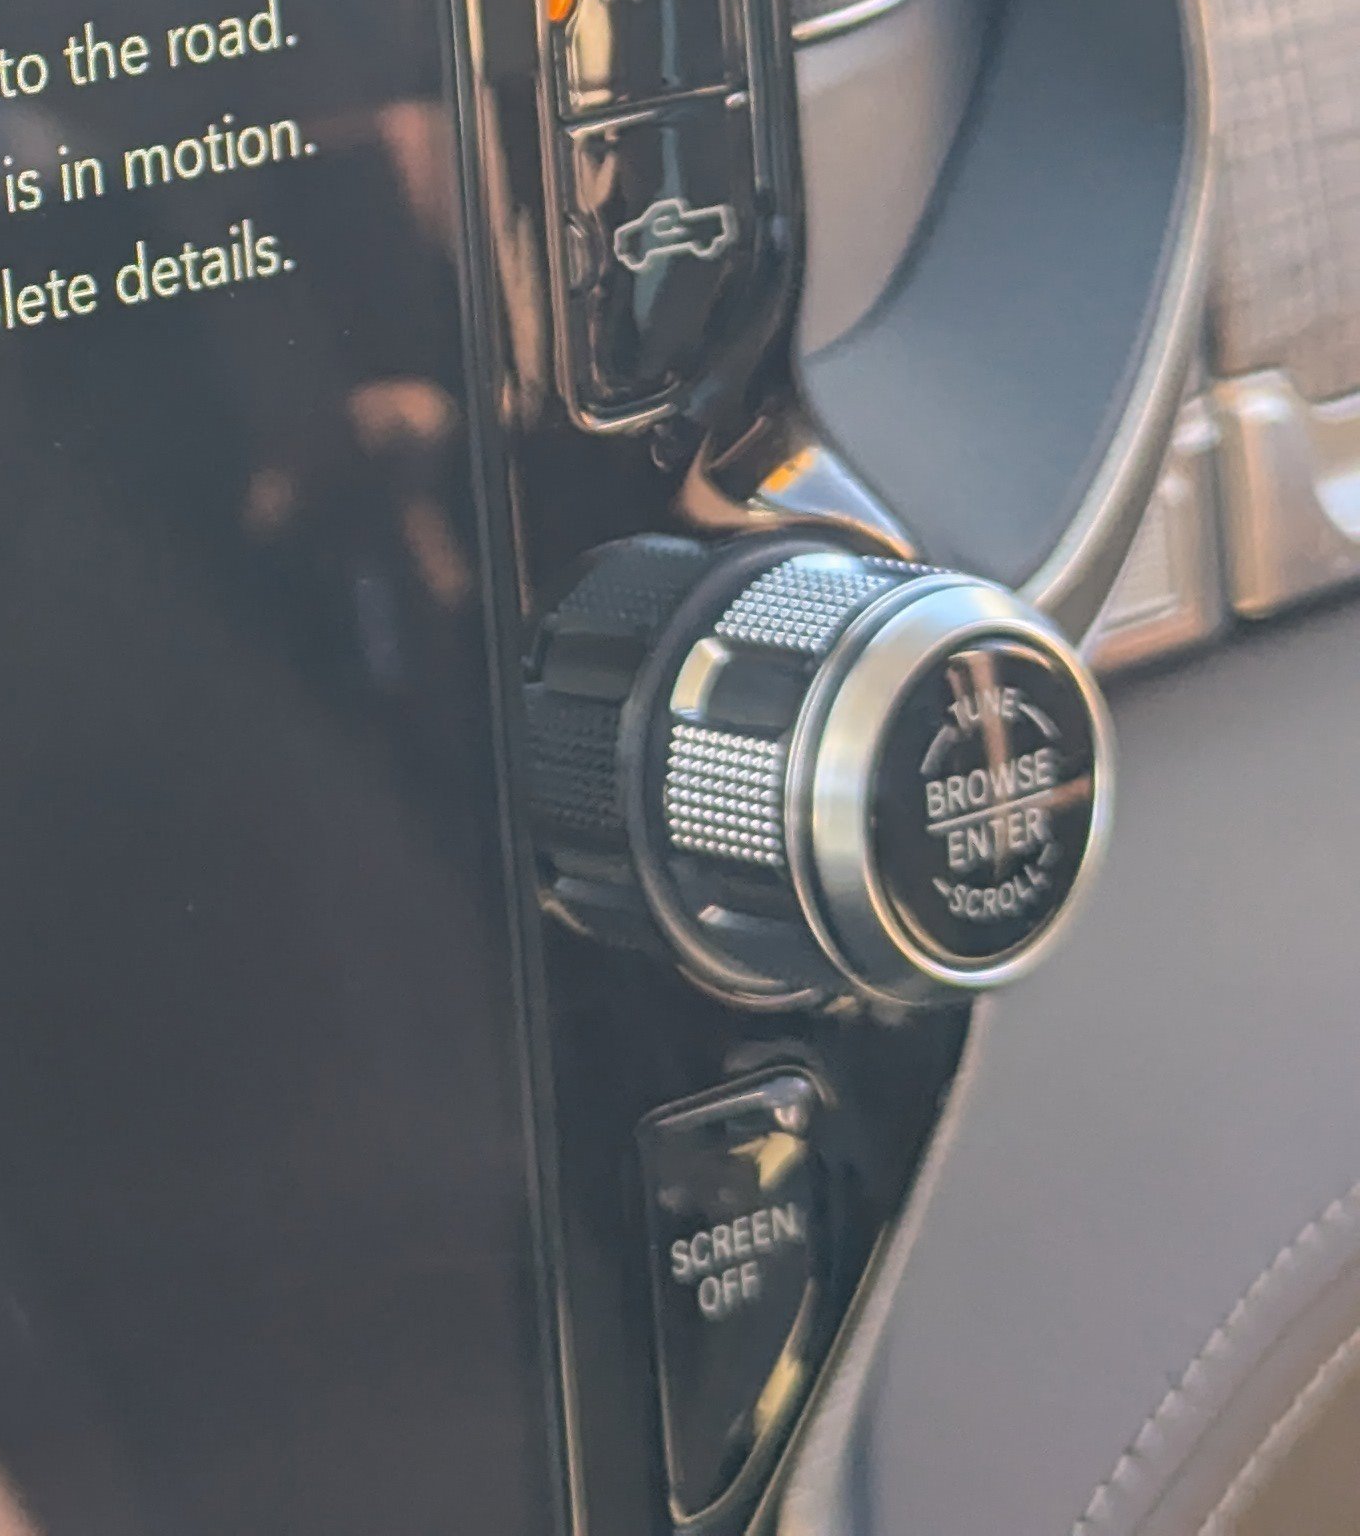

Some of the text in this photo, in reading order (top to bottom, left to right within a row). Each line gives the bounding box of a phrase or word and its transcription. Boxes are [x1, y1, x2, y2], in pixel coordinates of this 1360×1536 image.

[65, 23, 149, 88] the
[5, 158, 43, 213] is
[60, 147, 105, 202] in
[124, 114, 318, 190] motion.
[114, 220, 297, 306] details.
[926, 748, 1055, 816] BROWSE
[948, 807, 1048, 868] ENTER
[948, 866, 1047, 917] SCROLL
[671, 1203, 804, 1282] SCREEN
[699, 1262, 761, 1318] OFF
